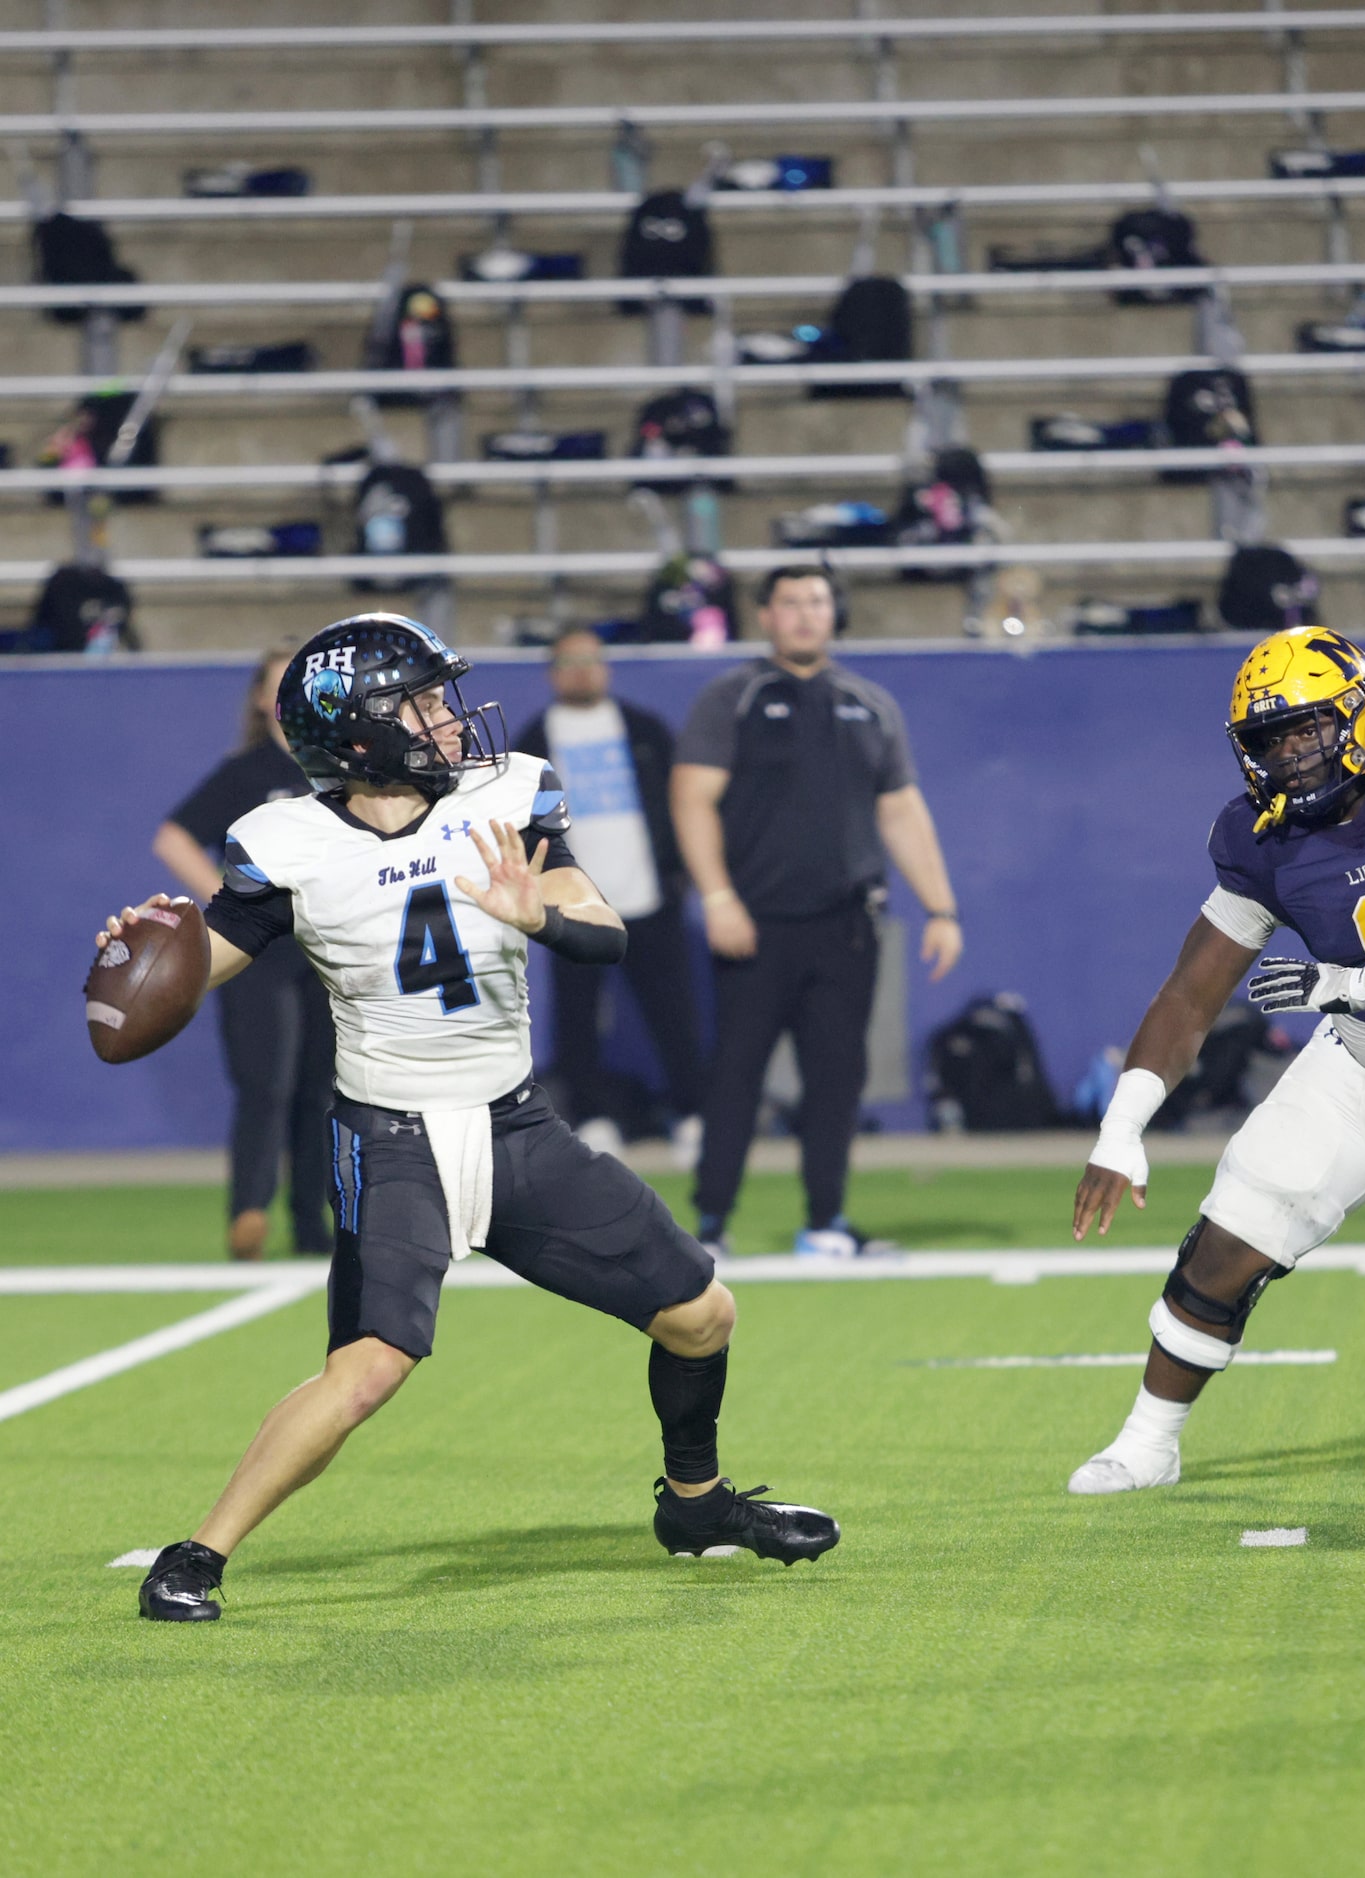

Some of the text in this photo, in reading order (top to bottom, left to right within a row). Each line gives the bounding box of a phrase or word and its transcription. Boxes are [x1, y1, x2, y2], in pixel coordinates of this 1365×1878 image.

[303, 646, 356, 682] RH
[1253, 697, 1277, 714] GRIT
[378, 856, 437, 886] The Hill
[393, 879, 481, 1016] 4
